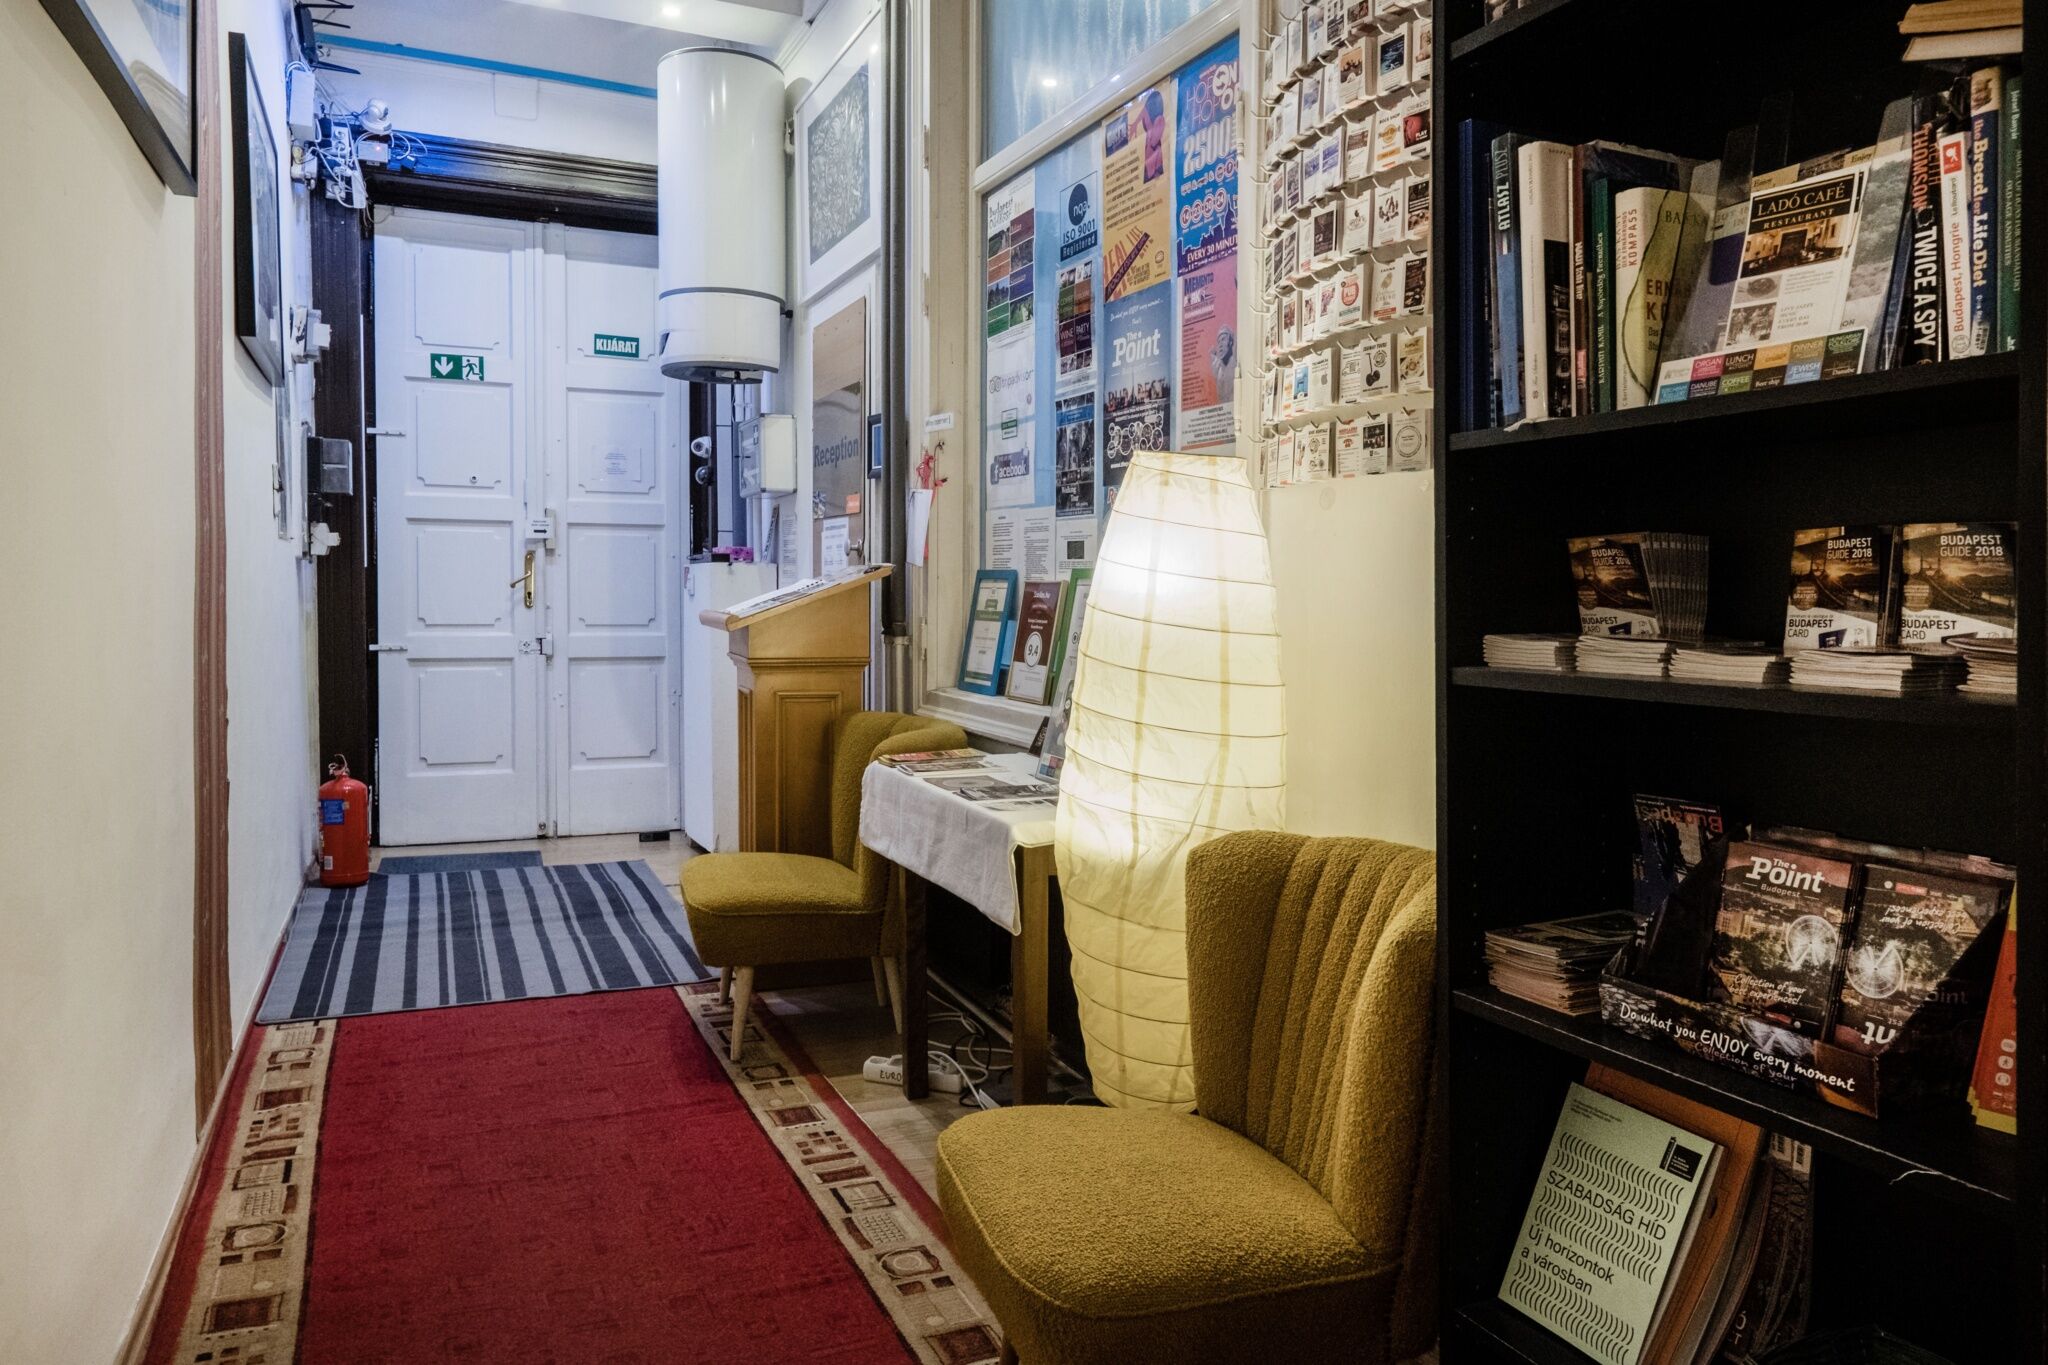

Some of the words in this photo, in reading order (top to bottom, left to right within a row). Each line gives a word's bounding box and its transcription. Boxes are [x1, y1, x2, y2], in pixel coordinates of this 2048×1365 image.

[1494, 148, 1508, 180] PLUSZ
[1912, 130, 1930, 212] THOMSON
[1973, 138, 1990, 198] Bread
[1496, 182, 1510, 231] ATLASZ
[1757, 192, 1800, 216] LADÓ
[1803, 182, 1846, 206] CAFÉ
[1973, 197, 1984, 216] for
[1763, 208, 1835, 230] RESTAURANT
[1973, 212, 1989, 250] Life
[1063, 229, 1076, 245] ISO
[1077, 219, 1096, 238] 9001
[1628, 208, 1638, 267] KOMPASS
[1187, 246, 1206, 264] EVERY
[1206, 243, 1215, 256] 30
[1913, 225, 1938, 291] TWICE
[1951, 222, 1964, 271] Hongrie
[1973, 249, 1988, 288] Diet
[1913, 294, 1937, 308] A
[1952, 272, 1965, 333] Budapest,
[1126, 331, 1138, 343] The
[1913, 308, 1937, 346] SPY
[595, 337, 638, 354] KIJÁRAT
[1111, 328, 1161, 368] Point
[1695, 356, 1722, 369] ORGAN
[1725, 354, 1755, 367] LUNCH
[1793, 340, 1824, 352] DINNER
[1790, 361, 1821, 374] JEWISH
[1690, 381, 1718, 391] DANUBE
[1721, 376, 1750, 388] COFFEE
[813, 436, 859, 468] Reception
[994, 460, 1027, 482] facebook
[1827, 537, 1873, 549] BUDAPEST
[1940, 534, 2002, 546] BUDAPEST
[1940, 546, 1972, 557] GUIDE
[1975, 546, 2004, 557] 2018
[1826, 549, 1850, 560] GUIDE
[1851, 548, 1873, 559] 2018
[1581, 616, 1618, 625] BUDAPEST
[1788, 618, 1834, 629] BUDAPEST
[1901, 619, 1957, 630] BUDAPEST
[1787, 628, 1810, 638] CARD
[1901, 630, 1926, 640] CARD
[1745, 856, 1825, 894] Point
[1773, 858, 1790, 869] The
[1760, 883, 1801, 898] Budapest
[1734, 973, 1775, 989] Collection
[1619, 1002, 1638, 1021] Do
[1640, 1012, 1673, 1033] what
[1674, 1024, 1697, 1040] you
[1699, 1028, 1750, 1057] ENJOY
[1753, 1050, 1790, 1075] every
[1794, 1064, 1857, 1093] moment
[1546, 1169, 1635, 1225] SZABADSÁG
[1637, 1216, 1667, 1242] HÍD
[1528, 1224, 1543, 1245] Új
[1544, 1233, 1615, 1285] horizontok
[1521, 1246, 1530, 1259] a
[1533, 1252, 1593, 1296] városban
